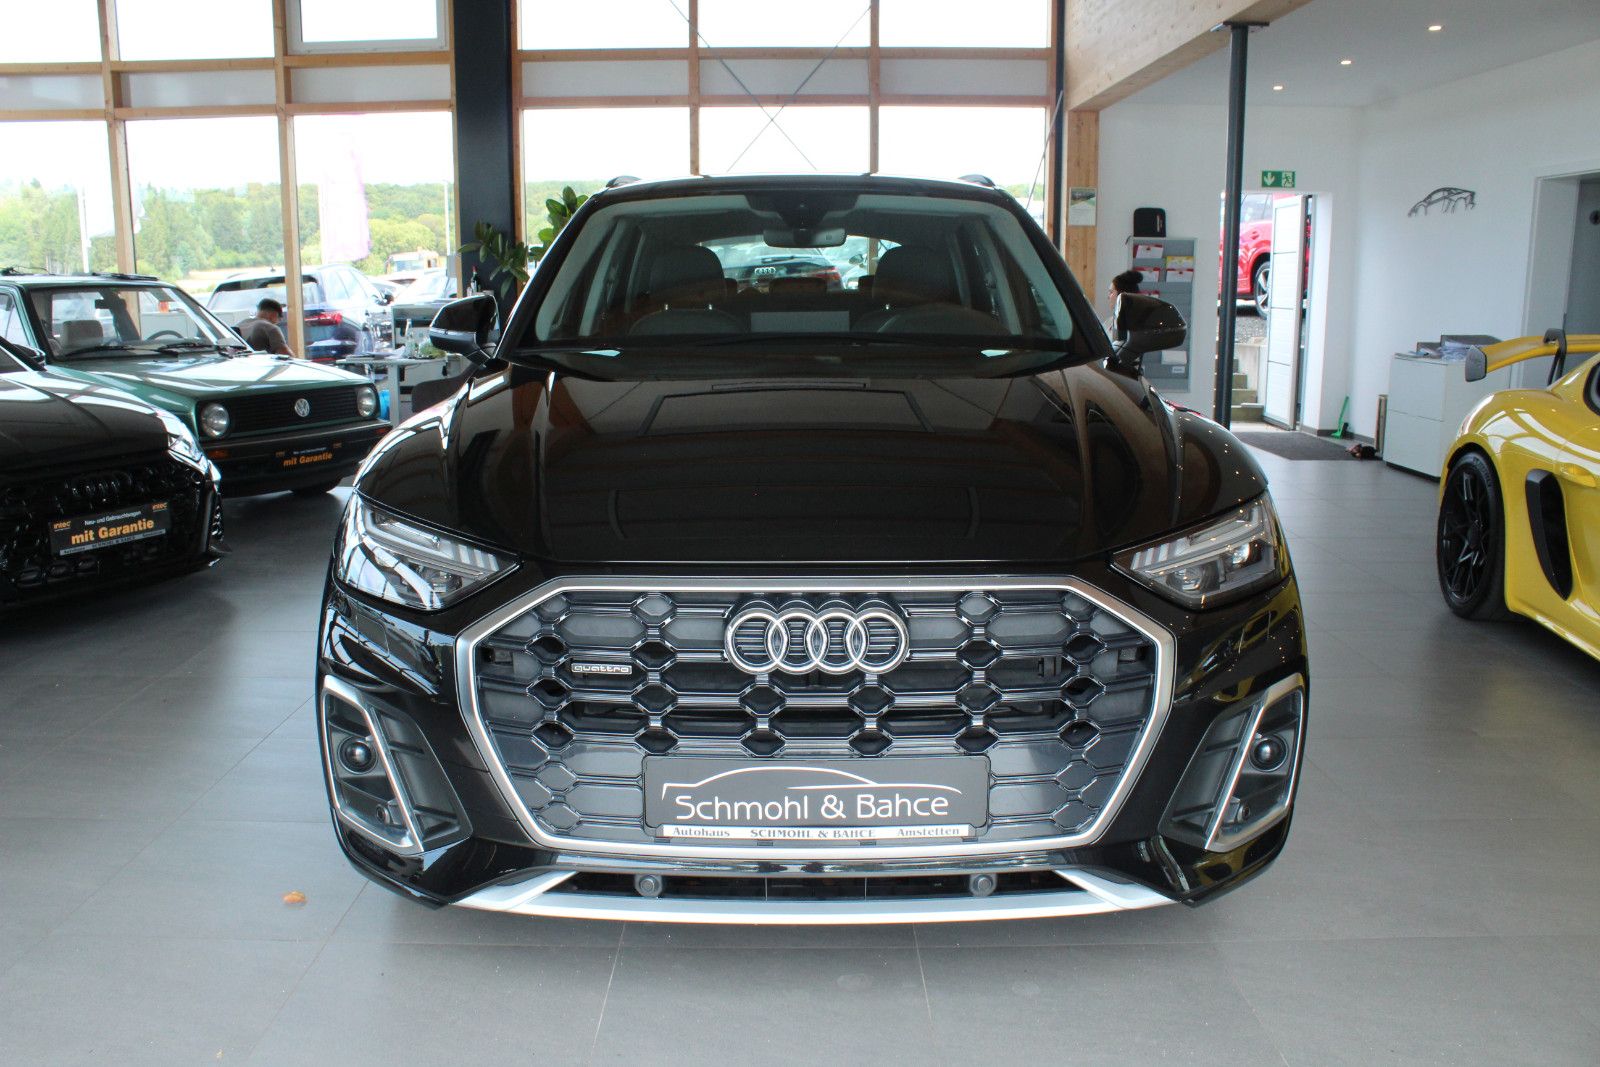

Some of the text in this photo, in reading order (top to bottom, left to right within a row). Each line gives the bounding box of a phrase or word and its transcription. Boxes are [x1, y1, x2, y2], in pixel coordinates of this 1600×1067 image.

[283, 452, 333, 467] mit Garantie
[71, 529, 95, 545] mit
[98, 518, 155, 539] Garantie
[574, 665, 629, 673] quattro
[675, 793, 949, 820] Schmohl & Bahce
[672, 827, 961, 838] Autohaus SCHMOHL & BAHCE Amstetten
